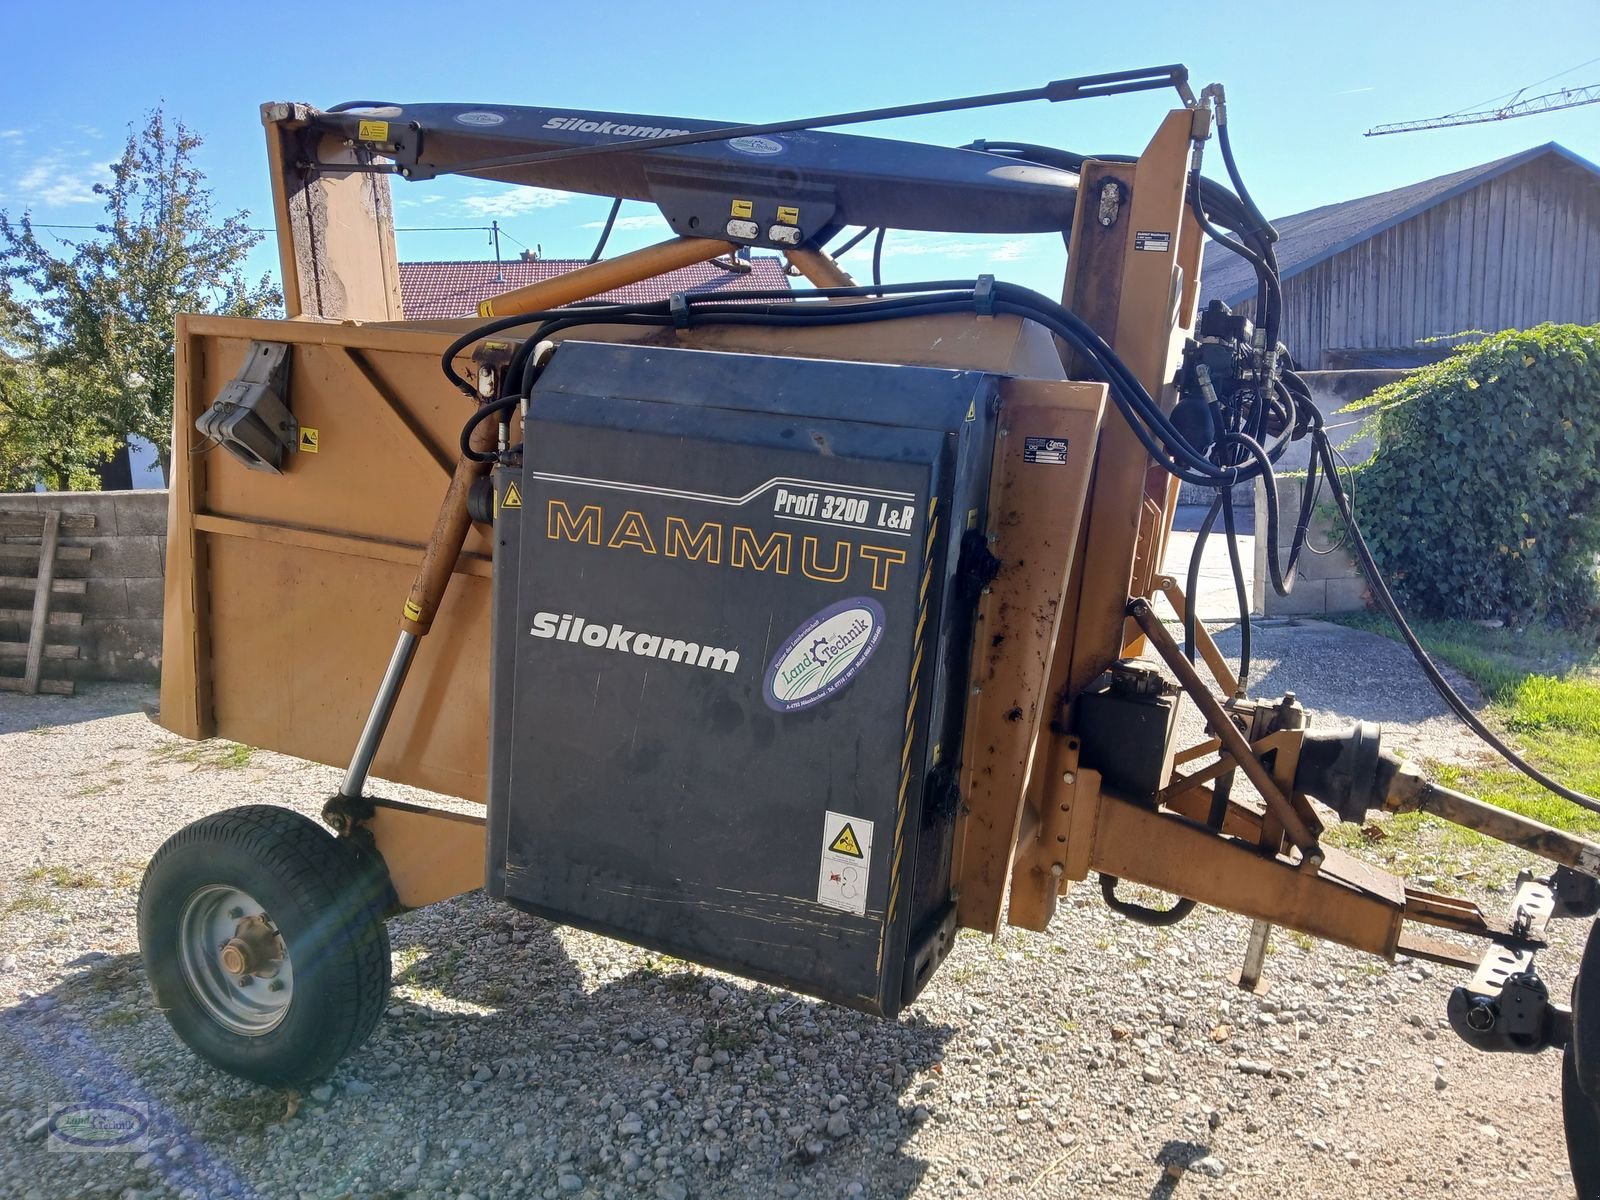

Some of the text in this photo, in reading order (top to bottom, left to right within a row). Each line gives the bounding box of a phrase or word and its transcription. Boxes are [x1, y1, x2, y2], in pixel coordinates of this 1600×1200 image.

[774, 489, 915, 530] Profi 3200 L&R
[547, 500, 906, 591] MAMMUT
[530, 611, 740, 674] Silokamm
[781, 653, 812, 685] Land
[822, 619, 868, 661] Technik
